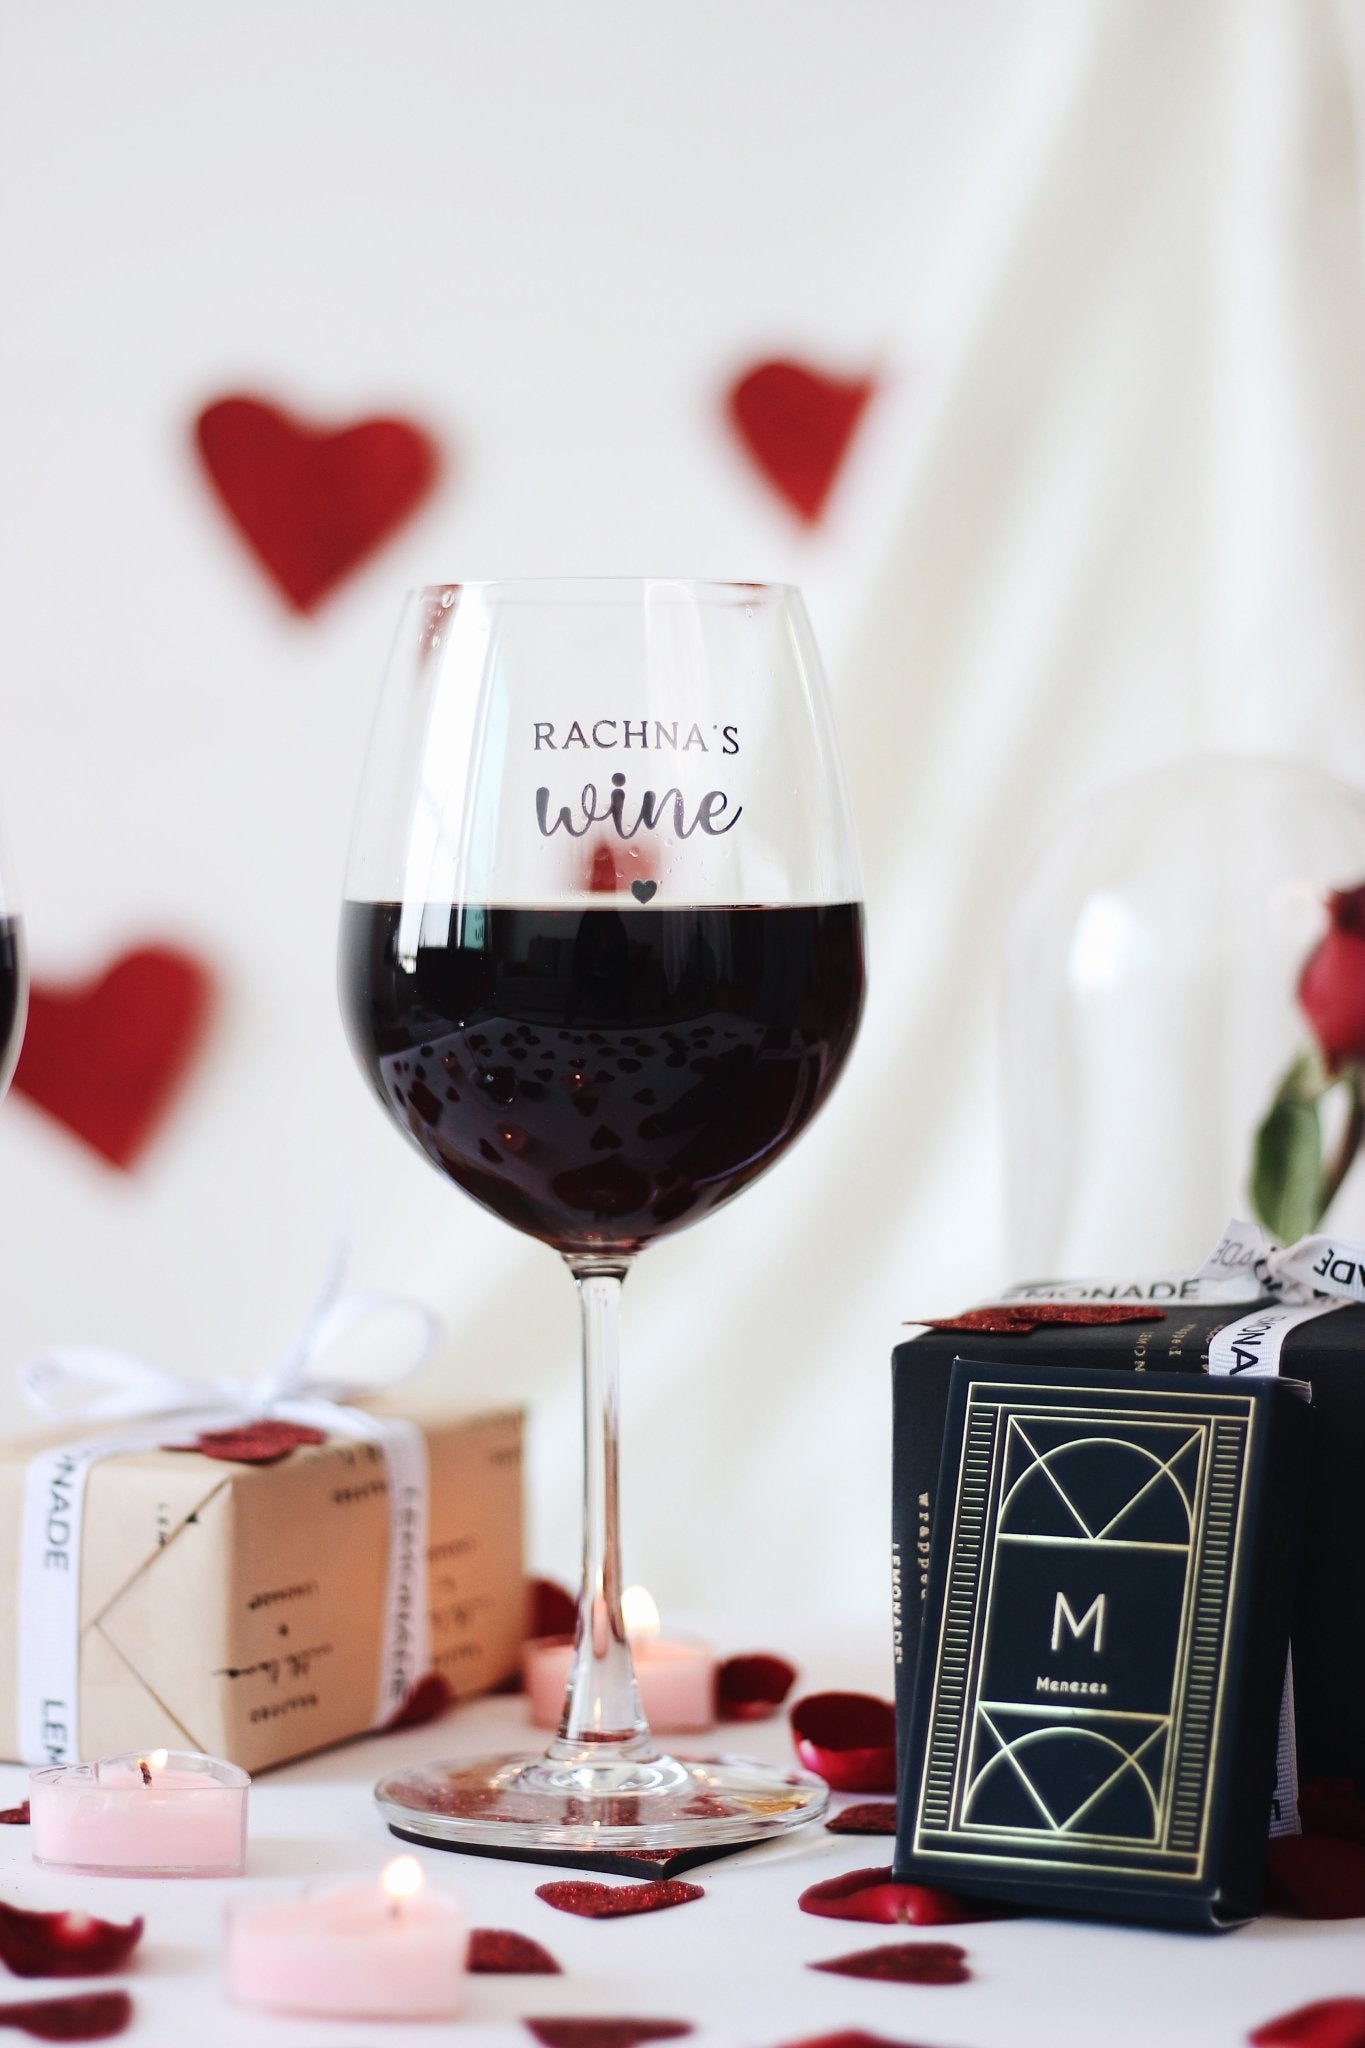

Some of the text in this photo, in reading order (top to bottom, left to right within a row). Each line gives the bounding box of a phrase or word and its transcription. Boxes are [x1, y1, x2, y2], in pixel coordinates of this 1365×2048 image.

[533, 719, 740, 754] RACHNA'S
[535, 772, 743, 839] wine
[1051, 1591, 1105, 1652] M
[1036, 1676, 1107, 1694] Menezes
